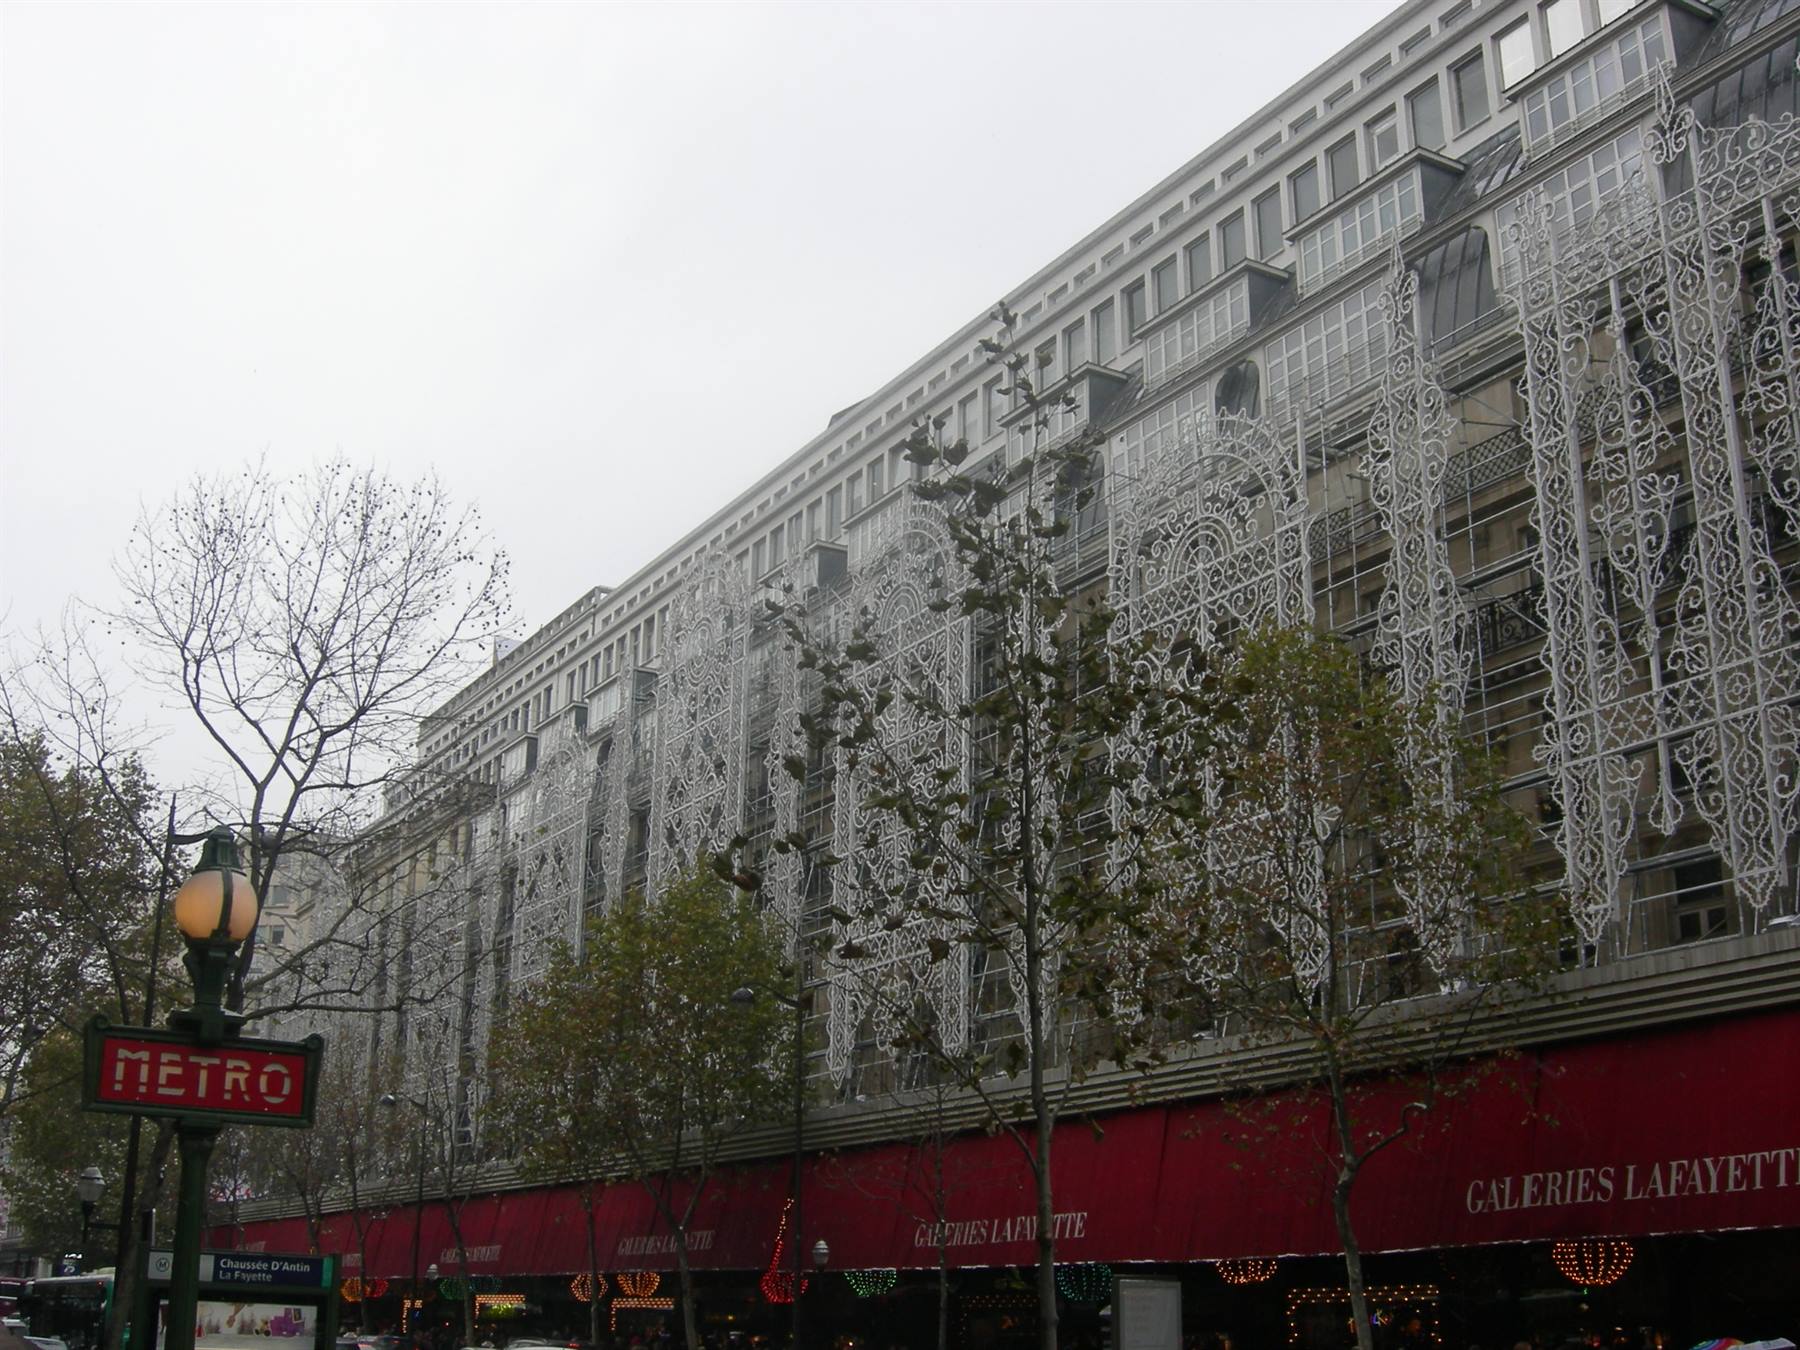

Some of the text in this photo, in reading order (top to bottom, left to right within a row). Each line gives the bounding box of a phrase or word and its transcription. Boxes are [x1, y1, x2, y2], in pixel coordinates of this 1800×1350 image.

[114, 1048, 291, 1104] METRO
[1466, 1147, 1800, 1214] GALERIES LAFAYETT
[990, 1212, 1088, 1243] LAFAYTTE
[219, 1258, 311, 1273] Chaussée D'Antin
[219, 1270, 273, 1283] La Fayette
